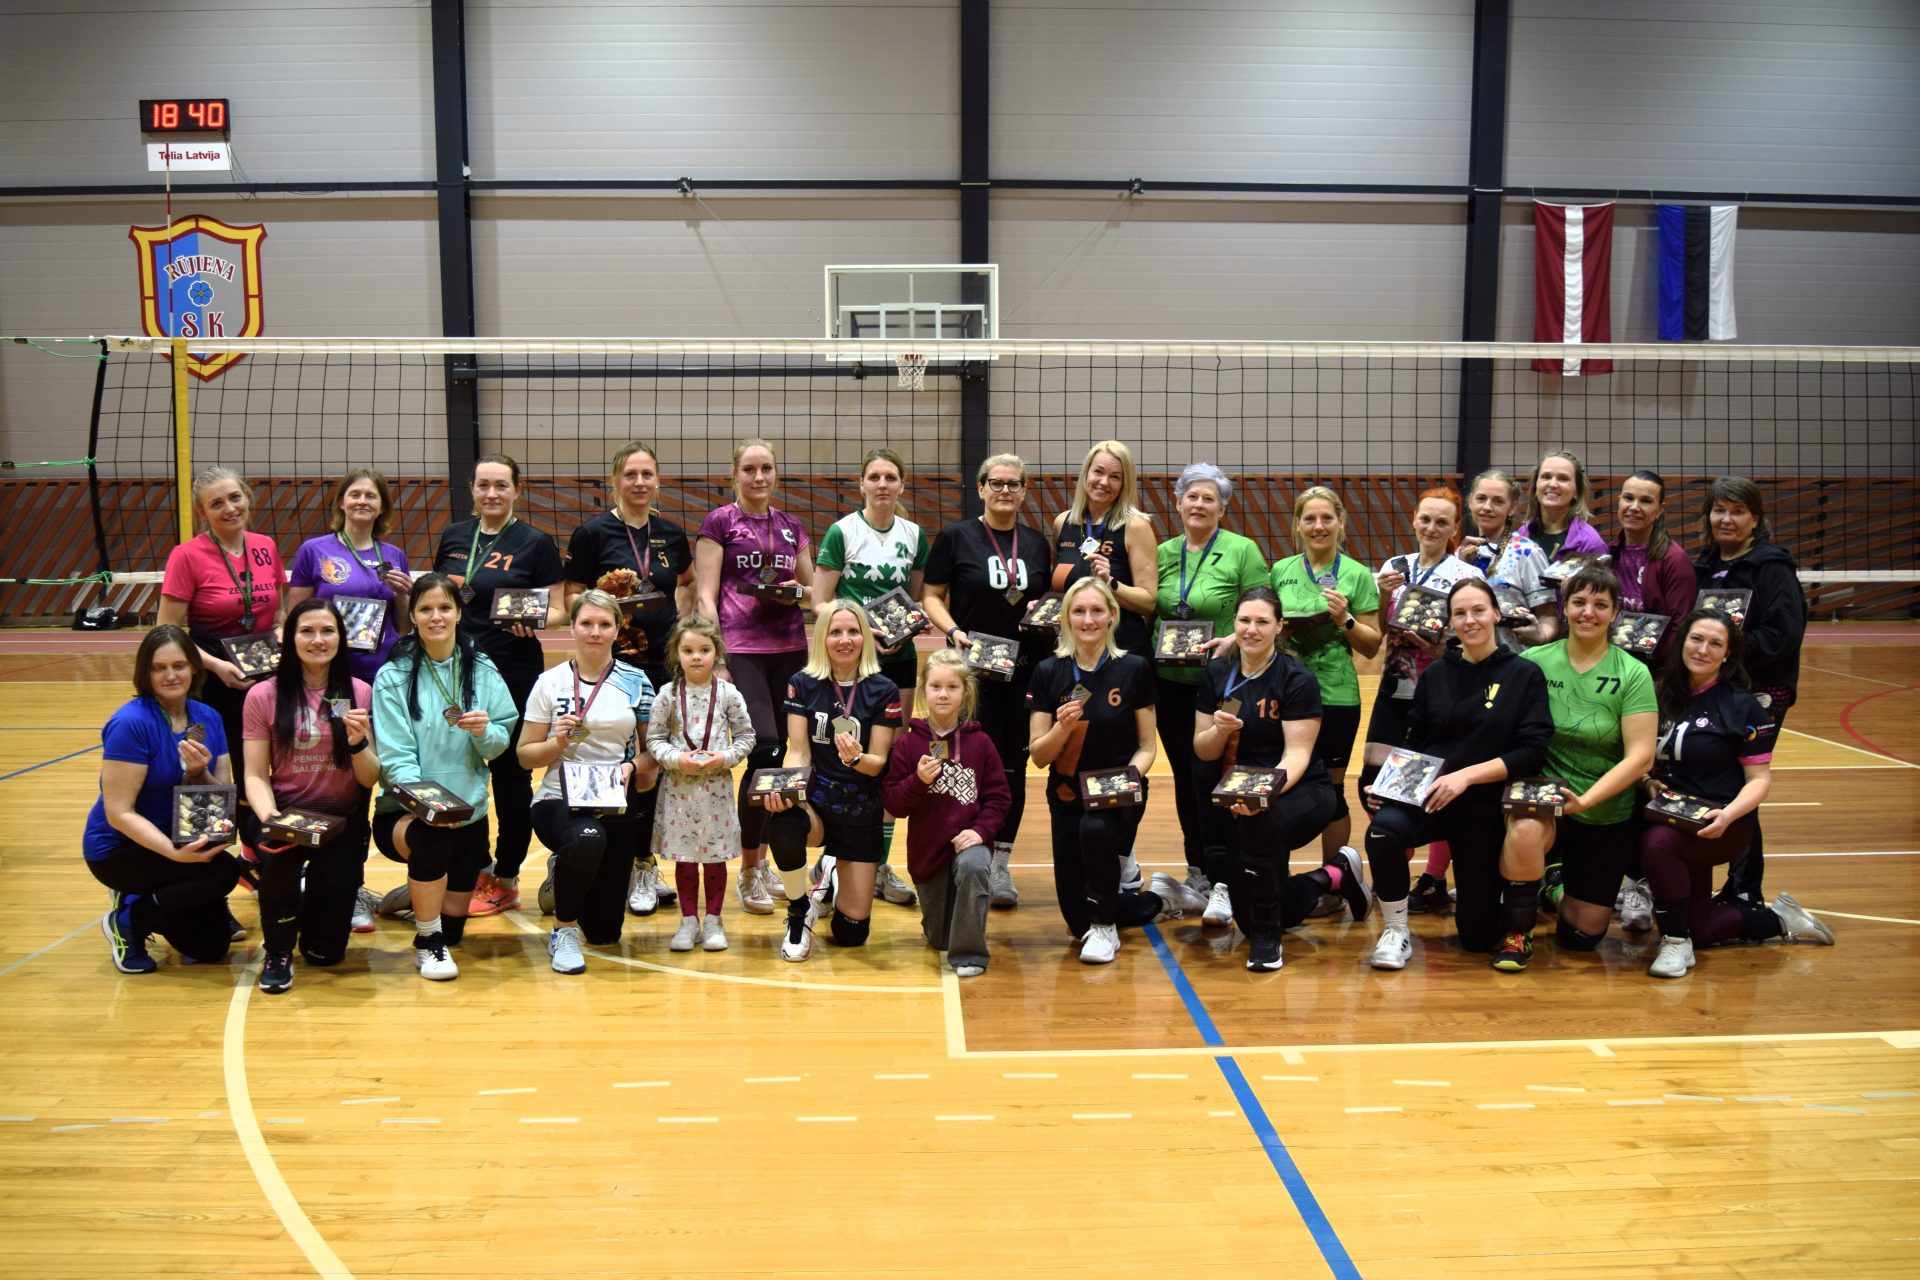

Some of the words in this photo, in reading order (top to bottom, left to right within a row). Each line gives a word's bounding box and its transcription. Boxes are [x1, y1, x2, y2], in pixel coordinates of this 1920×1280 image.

[153, 103, 178, 128] 18
[188, 102, 224, 127] 40
[158, 151, 183, 160] Telia
[185, 151, 220, 162] Latvija
[164, 255, 235, 282] RŪJIENA
[251, 548, 272, 566] 88
[484, 551, 513, 571] 21
[1210, 552, 1223, 566] 7
[987, 555, 1028, 591] 69
[1595, 675, 1621, 695] 77
[1107, 687, 1121, 707] 6
[1256, 698, 1280, 719] 18
